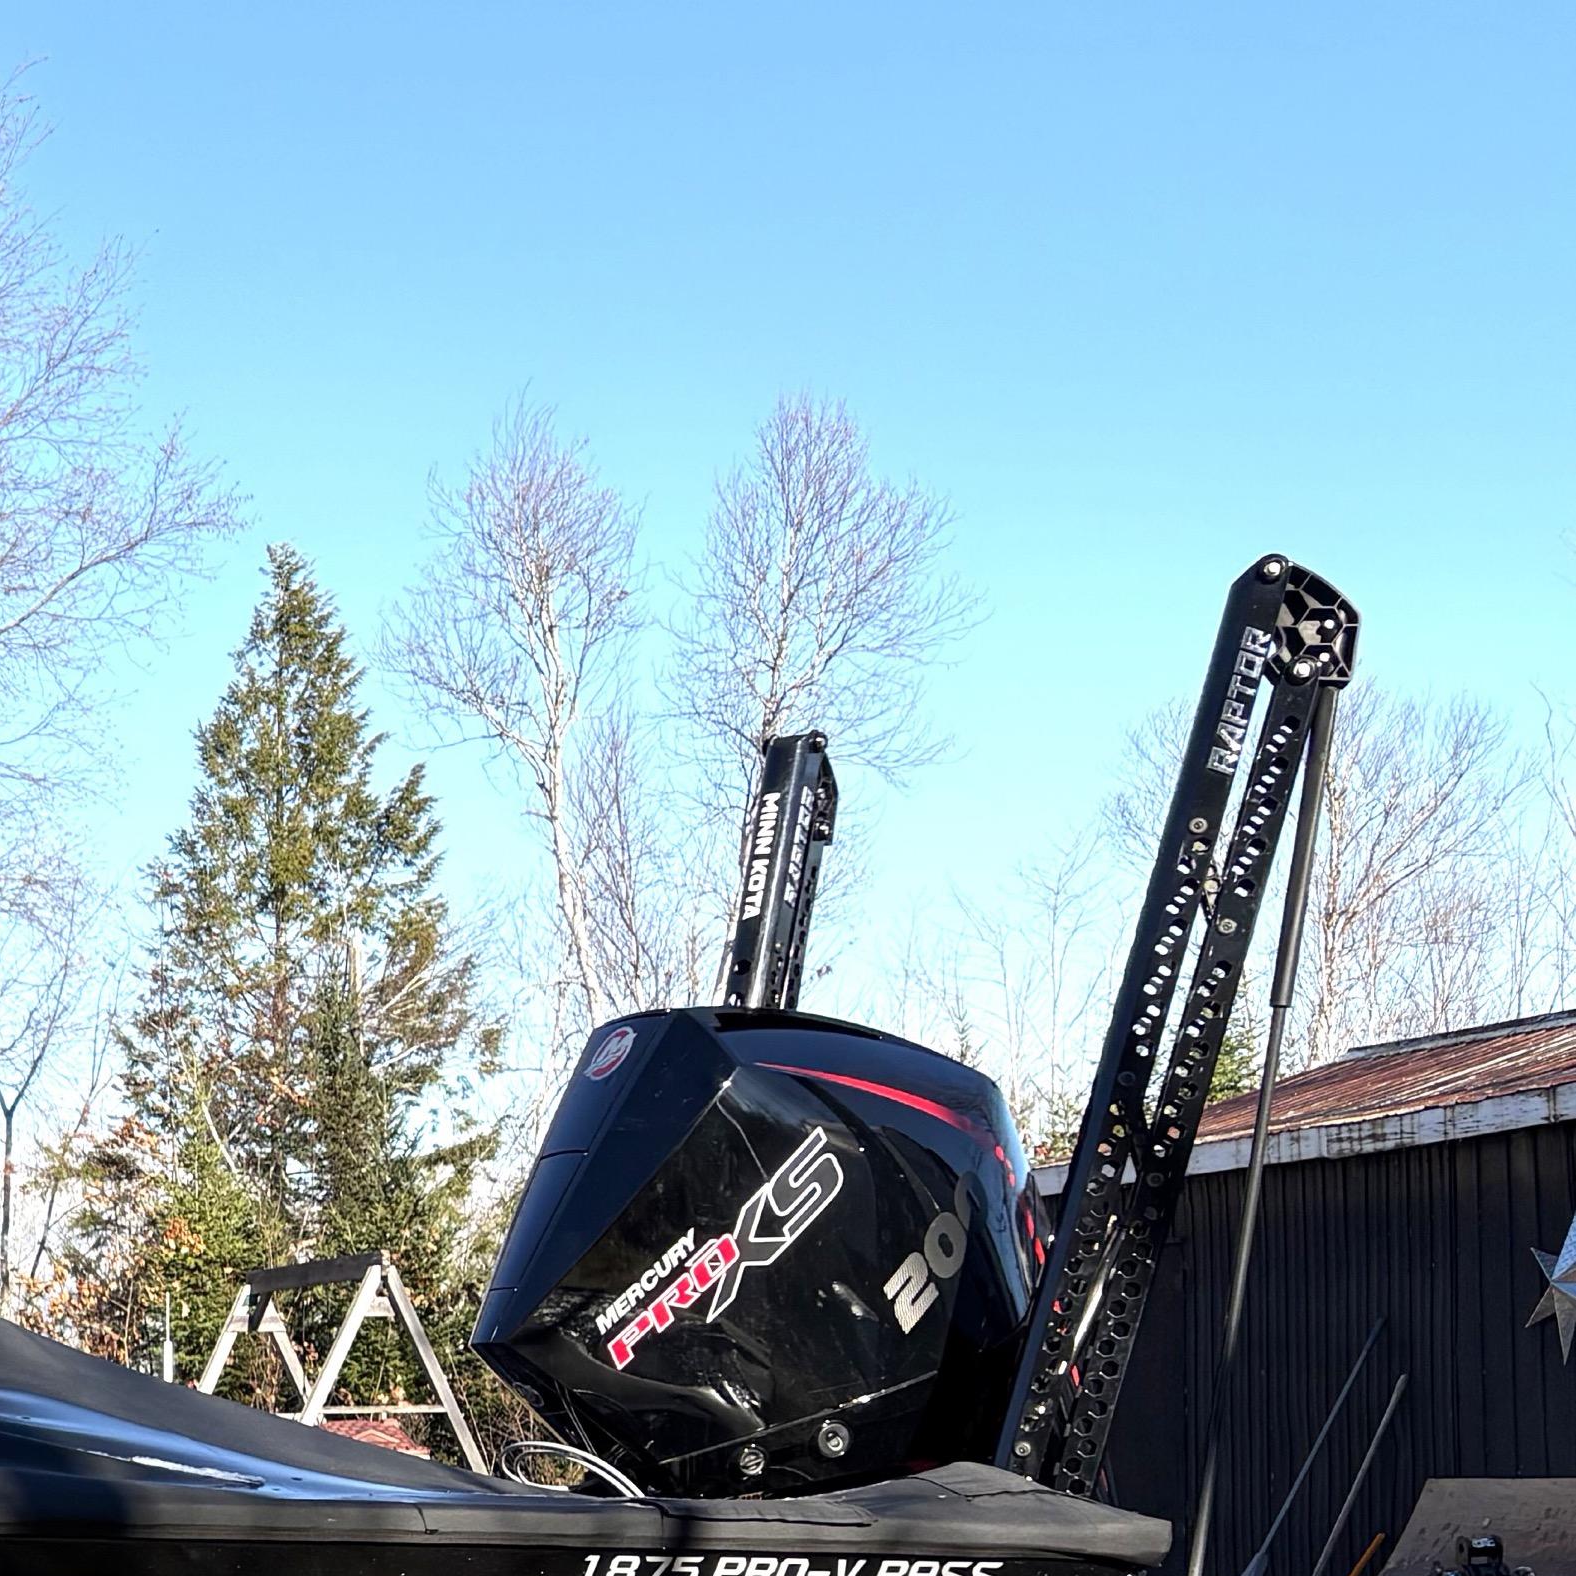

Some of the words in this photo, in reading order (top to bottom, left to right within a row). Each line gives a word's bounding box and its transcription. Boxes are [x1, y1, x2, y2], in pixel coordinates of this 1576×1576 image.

[1207, 626, 1271, 774] RAPTOR
[754, 792, 781, 855] MINN
[742, 858, 768, 920] KOTA
[595, 1228, 697, 1335] MERCURY
